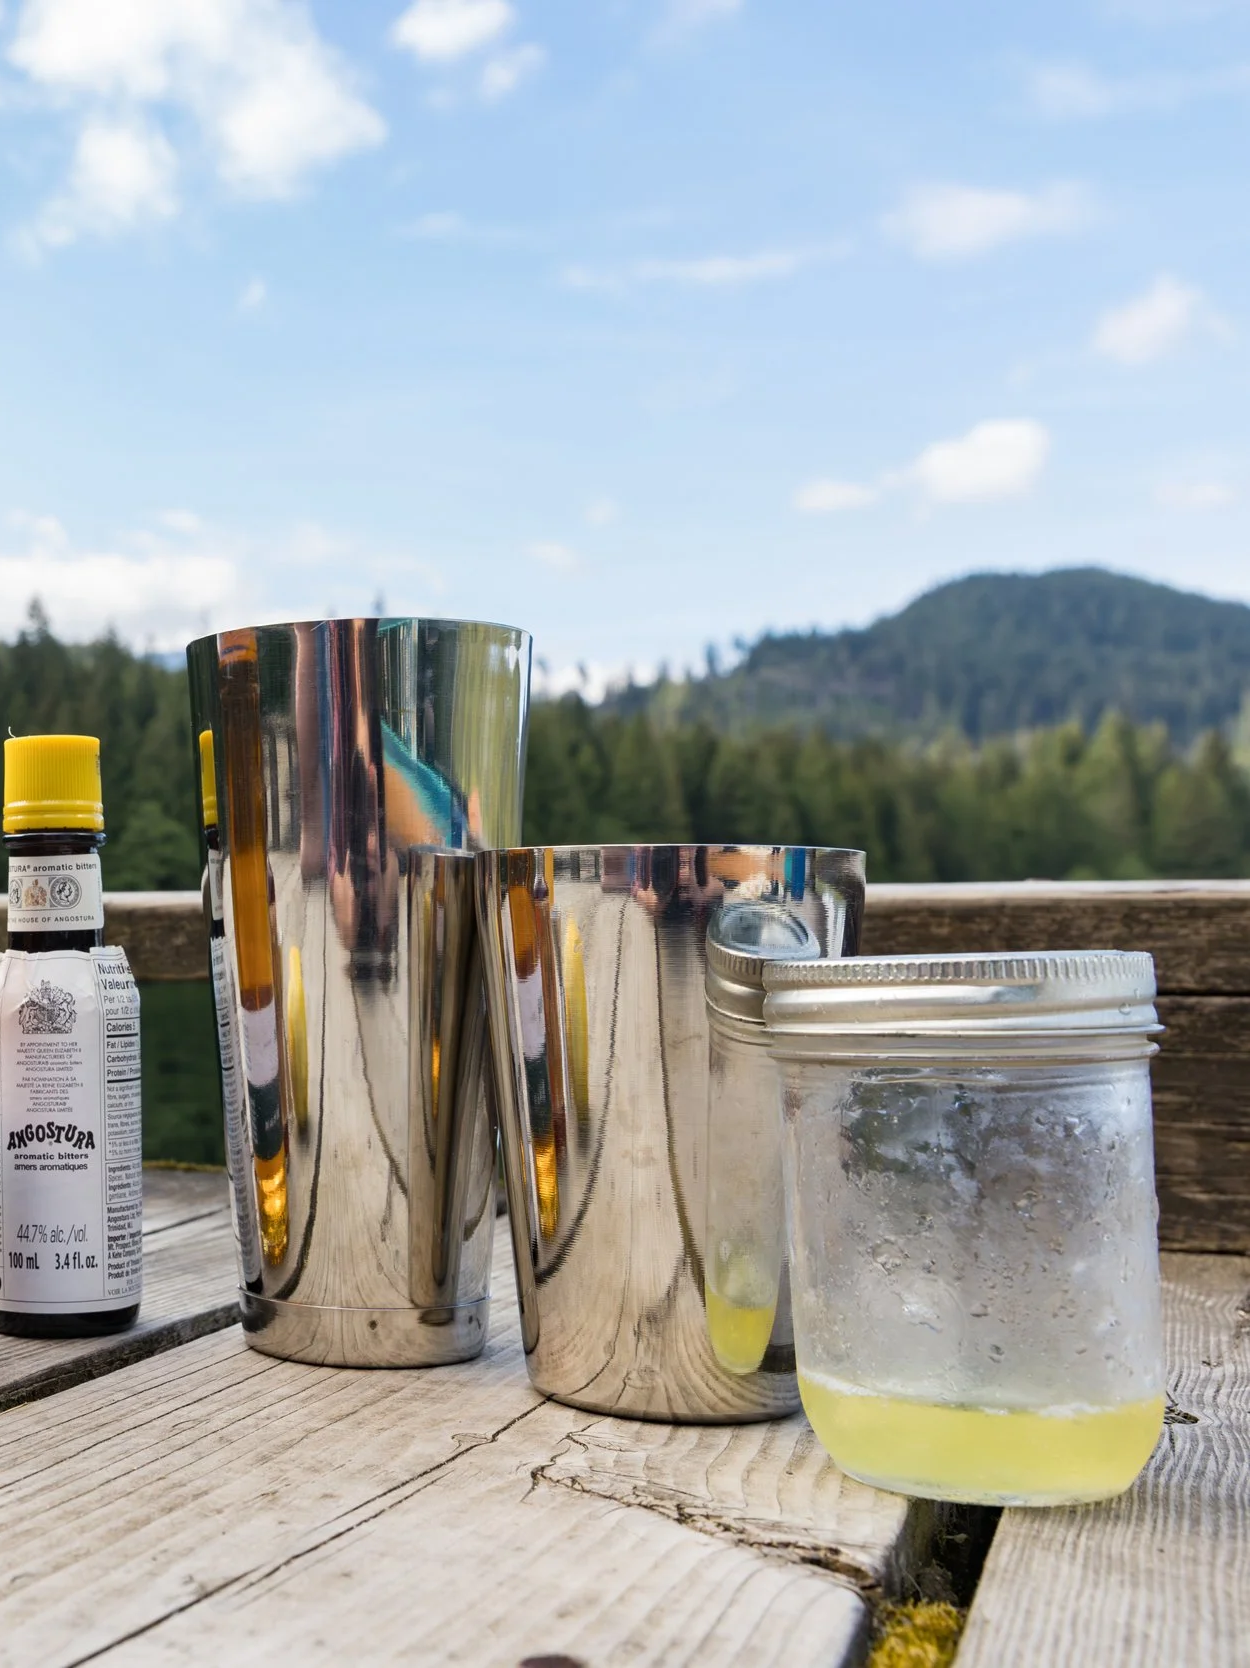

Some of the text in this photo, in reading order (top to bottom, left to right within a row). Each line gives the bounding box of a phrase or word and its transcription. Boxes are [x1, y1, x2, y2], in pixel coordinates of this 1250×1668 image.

[33, 863, 74, 873] aromatic
[54, 914, 95, 923] ANGOSTURA
[106, 1021, 132, 1032] Calories
[7, 1121, 96, 1151] ANGOSTURA
[14, 1152, 89, 1160] aromatic bitters
[14, 1162, 88, 1172] amers aromatiques
[16, 1223, 48, 1243] 44.7%
[50, 1223, 88, 1245] alc./vol.
[9, 1251, 98, 1270] 100 mL 3.4 fl. oz.
